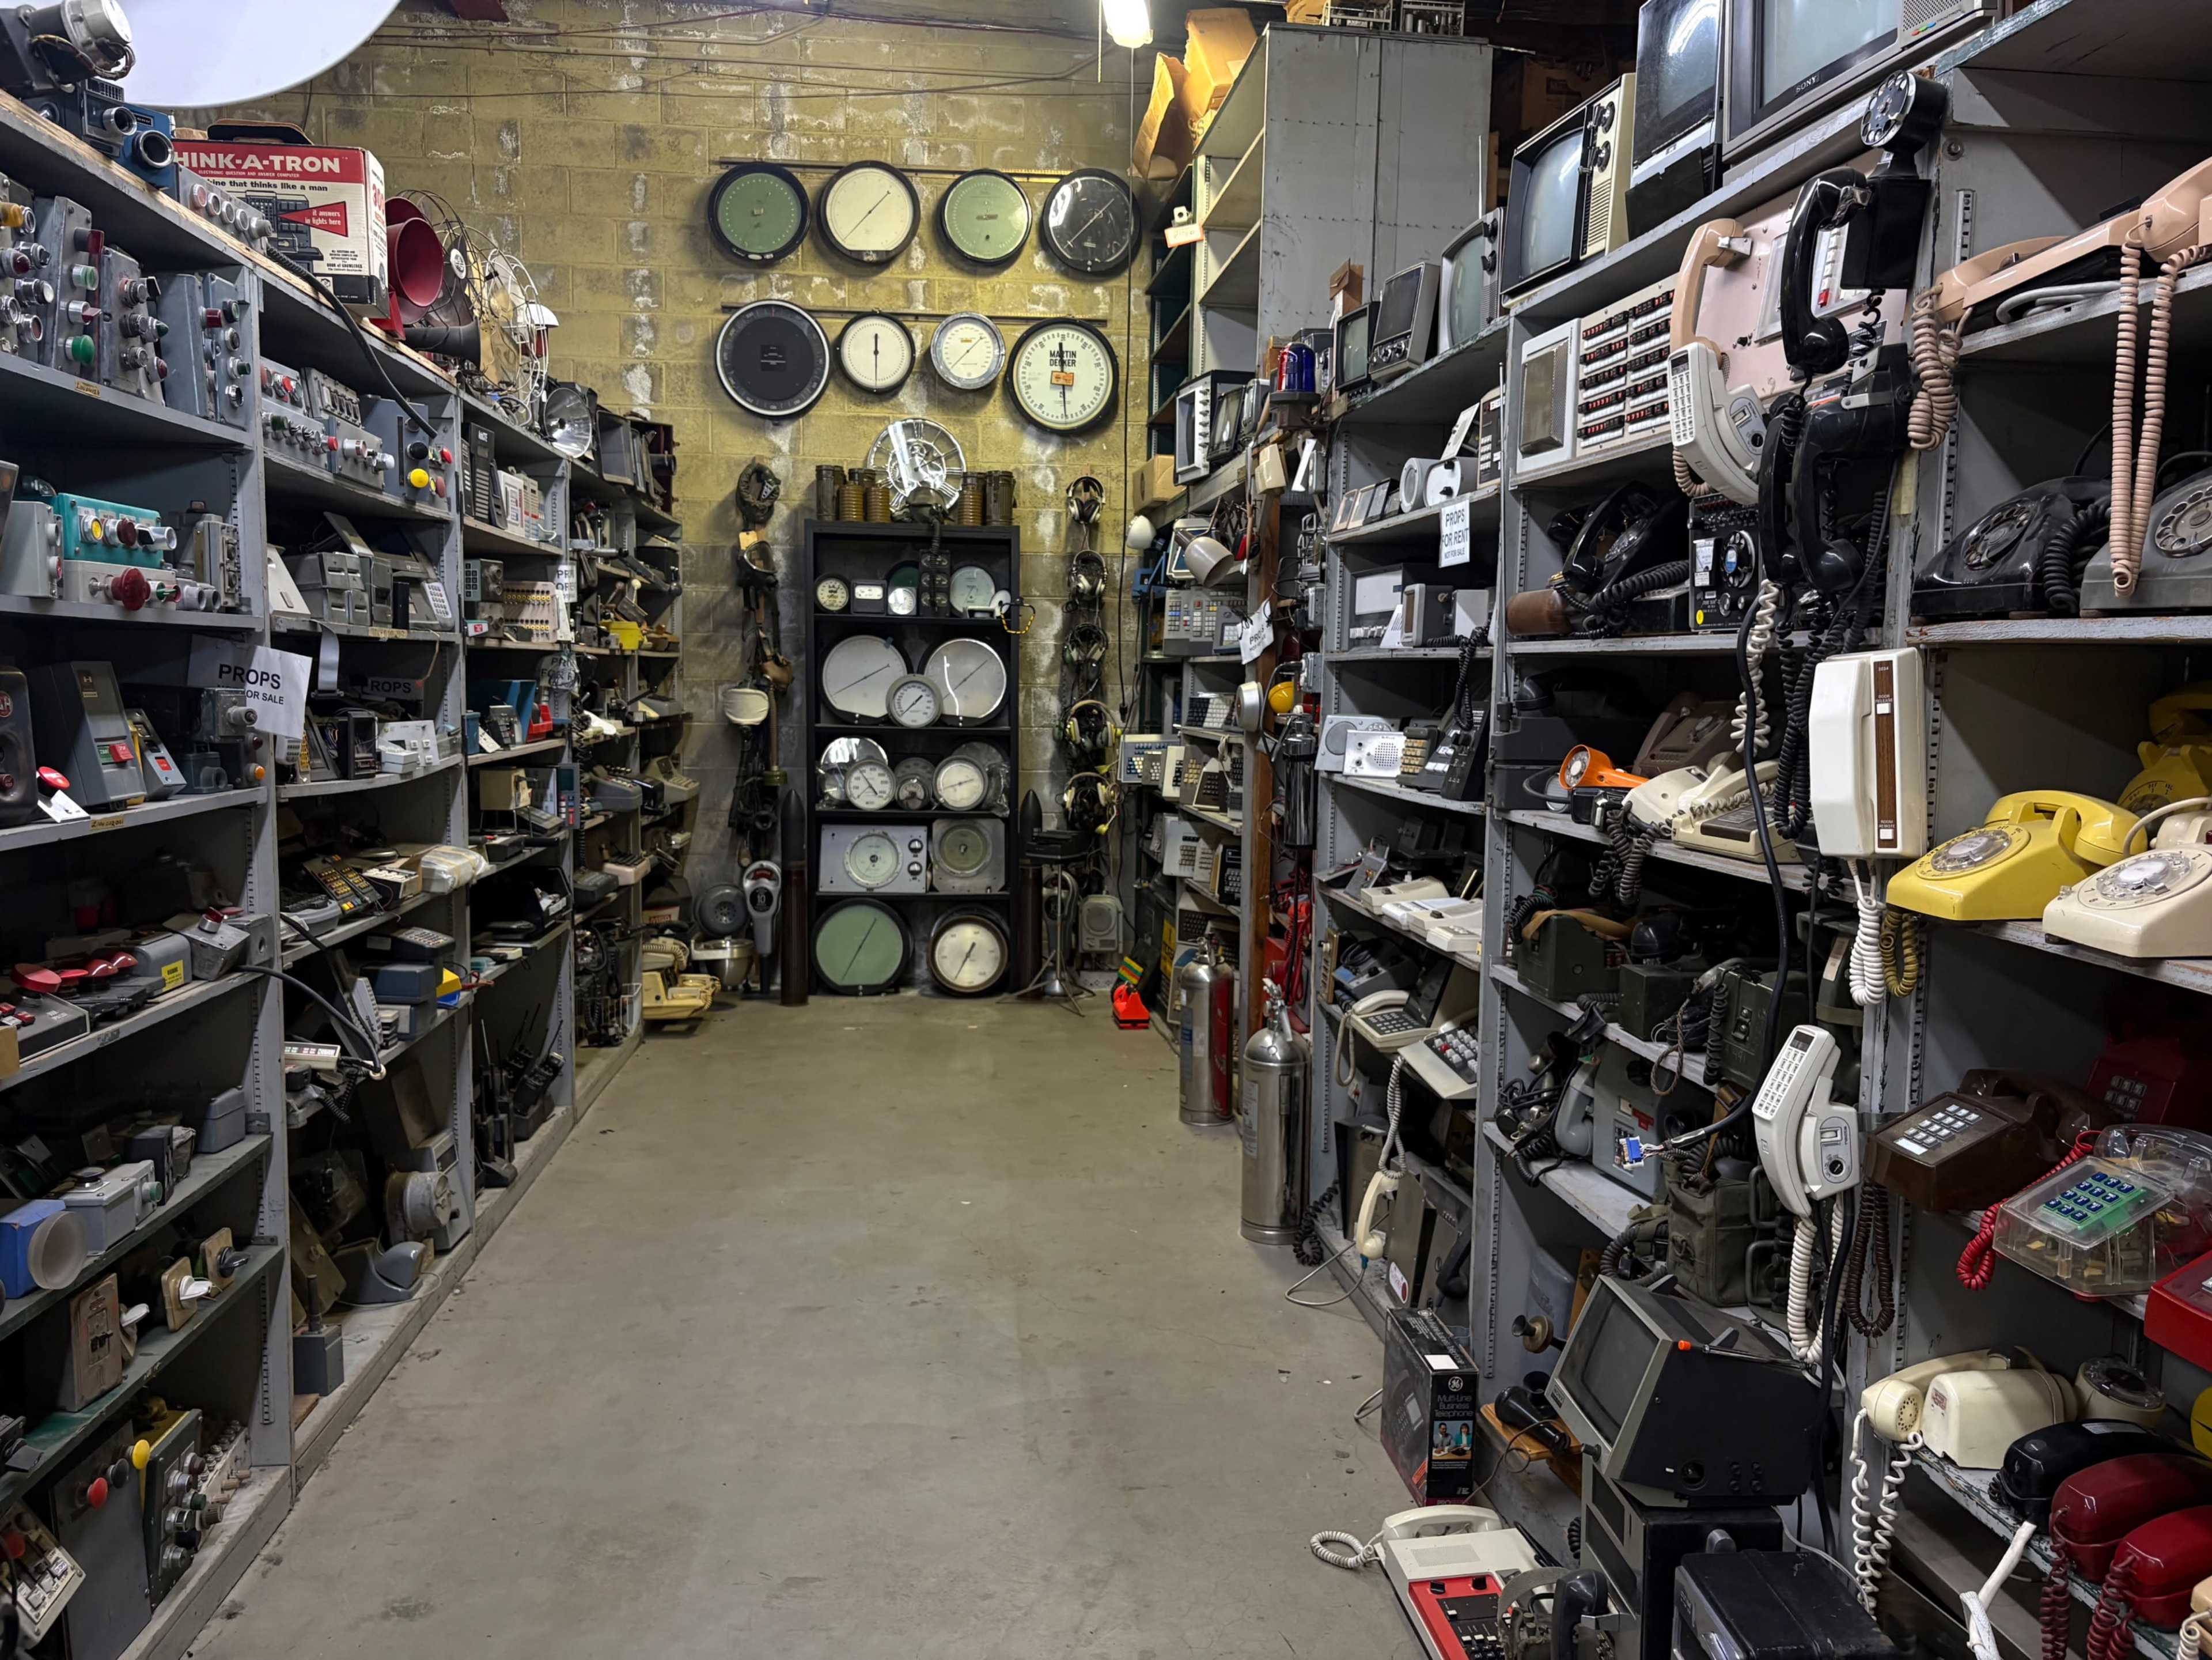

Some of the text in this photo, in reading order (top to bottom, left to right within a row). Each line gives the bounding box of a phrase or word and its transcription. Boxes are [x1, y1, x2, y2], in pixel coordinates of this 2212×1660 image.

[1796, 75, 1817, 92] SONY
[174, 151, 340, 173] HINK-A-TRON
[1050, 350, 1077, 358] MARTIN
[1050, 359, 1076, 367] DECKER
[1445, 509, 1465, 527] PROPS
[1453, 528, 1469, 546] RENT
[218, 663, 281, 689] PROPS
[370, 680, 412, 693] ROPS
[246, 690, 284, 705] OR SALE
[757, 894, 766, 904] 10
[1437, 1394, 1472, 1402] Multi-Line
[1439, 1401, 1469, 1410] Business
[1434, 1409, 1474, 1417] Telephone
